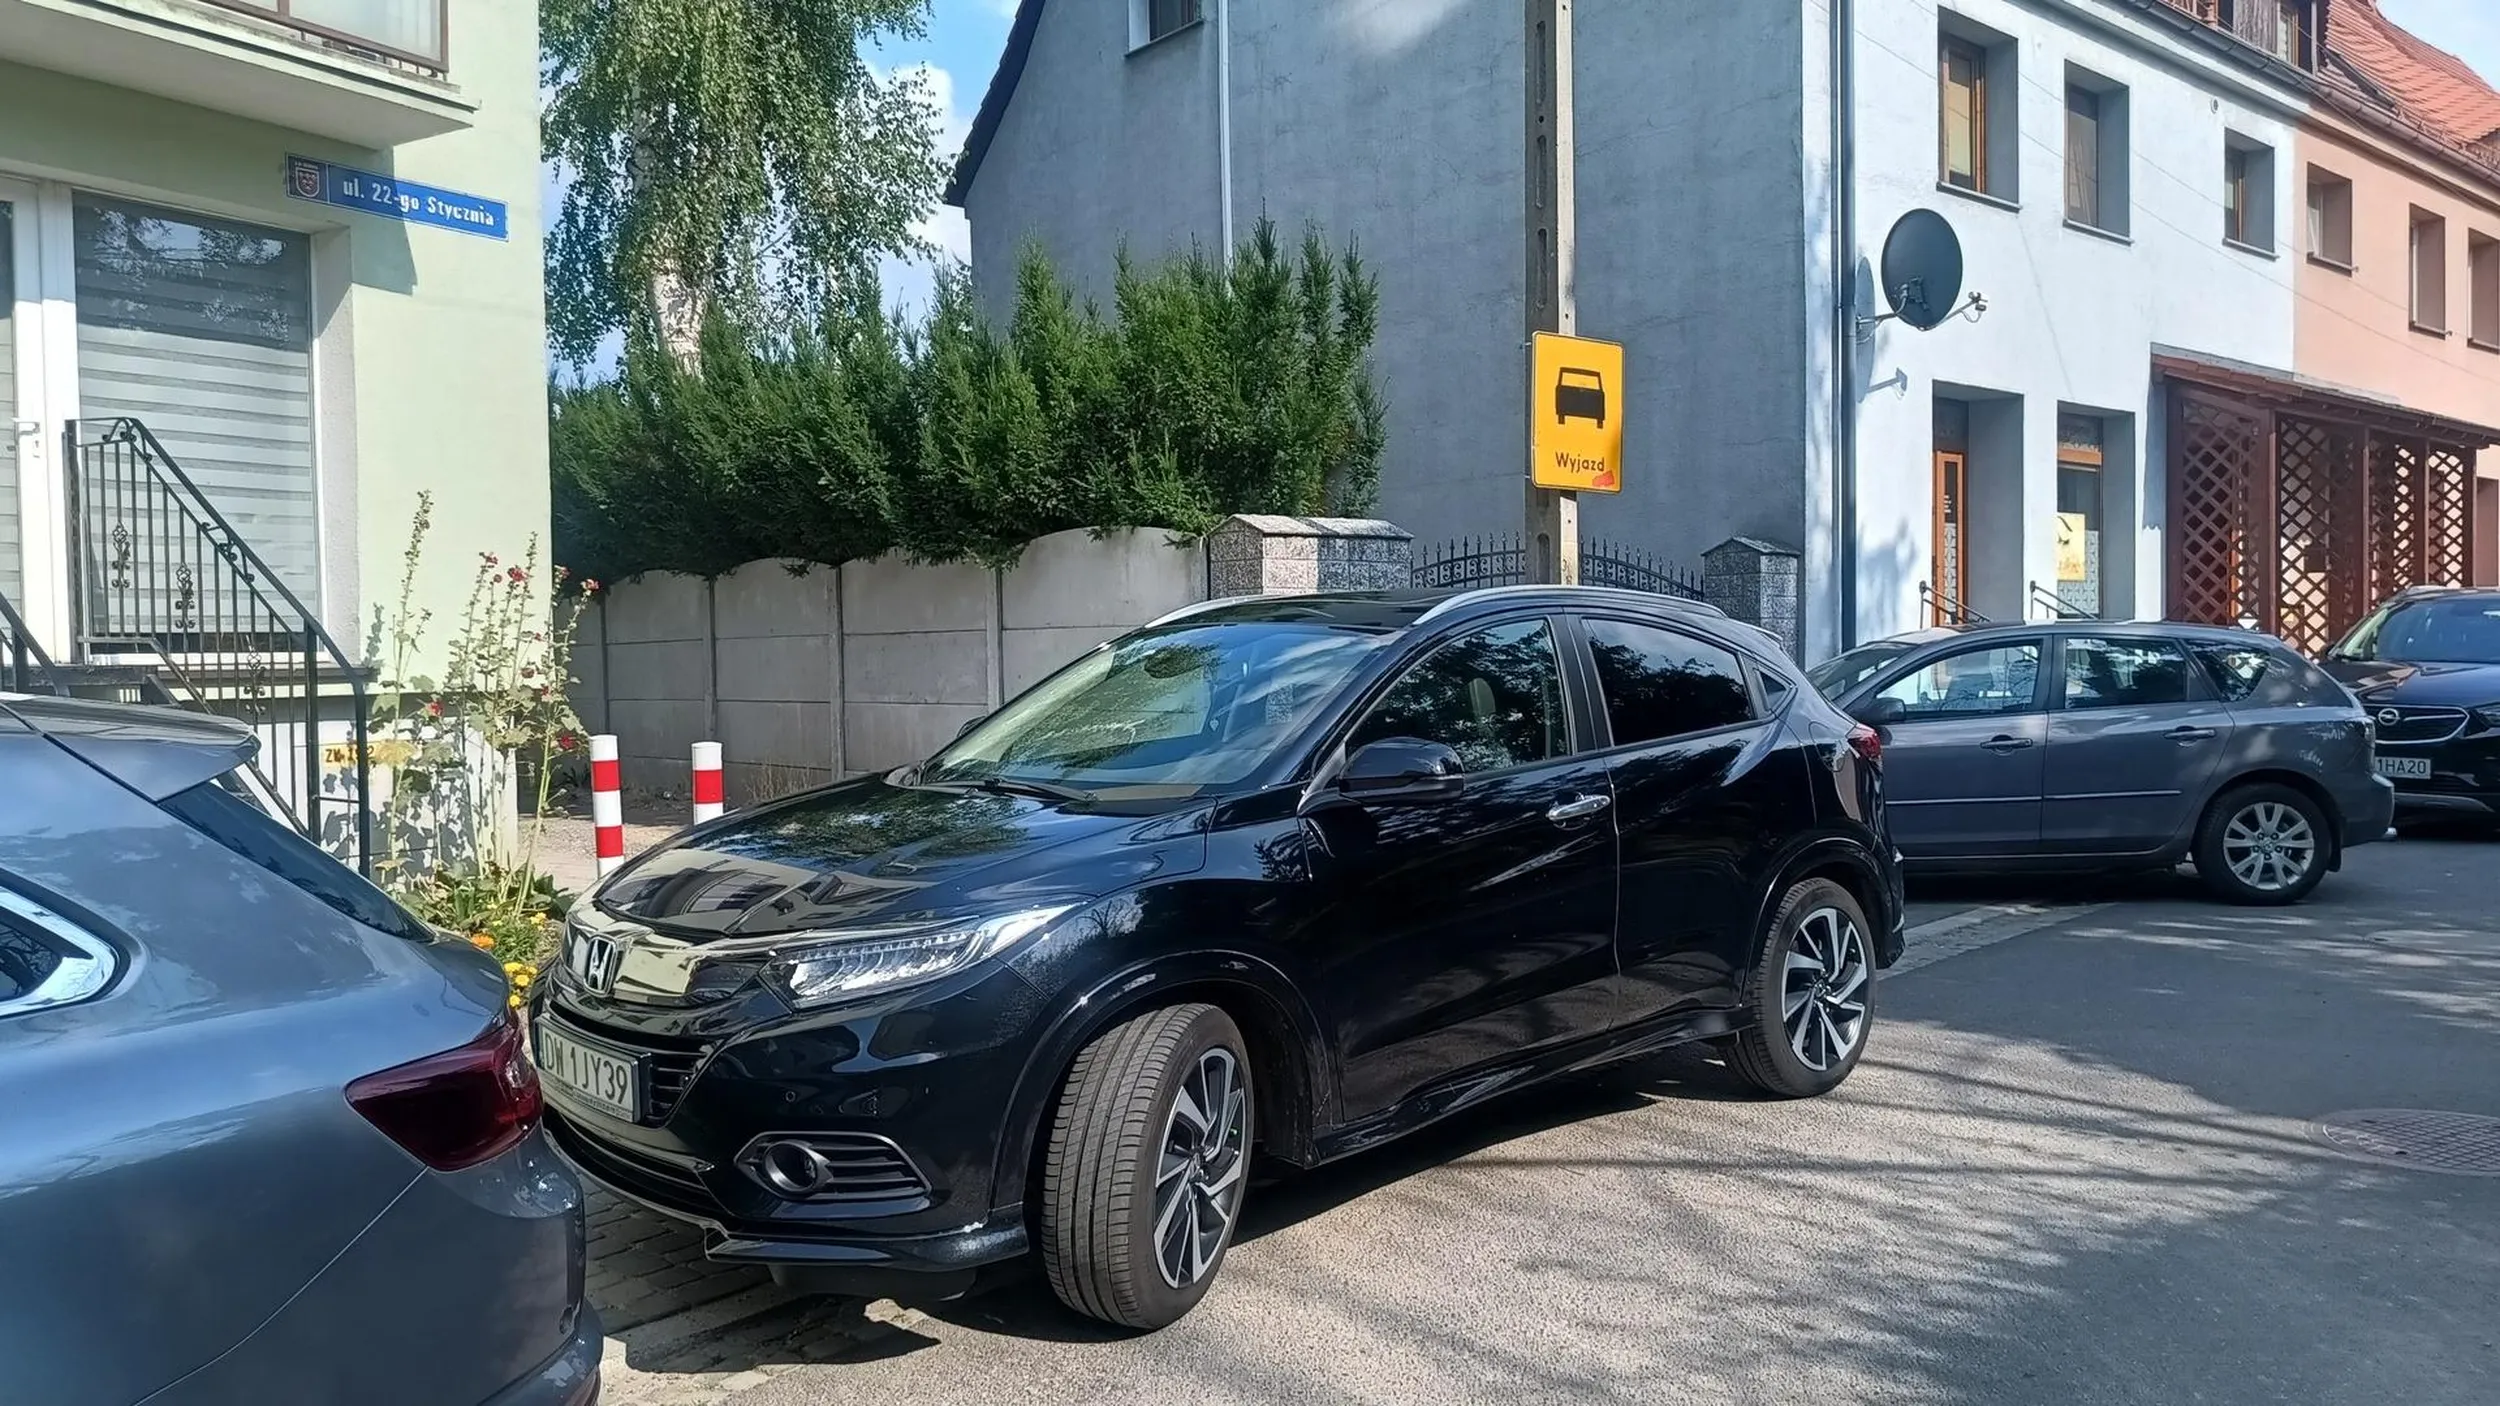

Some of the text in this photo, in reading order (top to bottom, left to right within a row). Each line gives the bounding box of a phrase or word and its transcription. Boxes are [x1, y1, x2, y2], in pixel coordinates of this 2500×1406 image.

[343, 178, 495, 226] ul. 22-go Stycznia
[1555, 451, 1605, 474] Wyjazd
[2377, 758, 2427, 775] 1HA20
[570, 1046, 628, 1105] 1JY39
